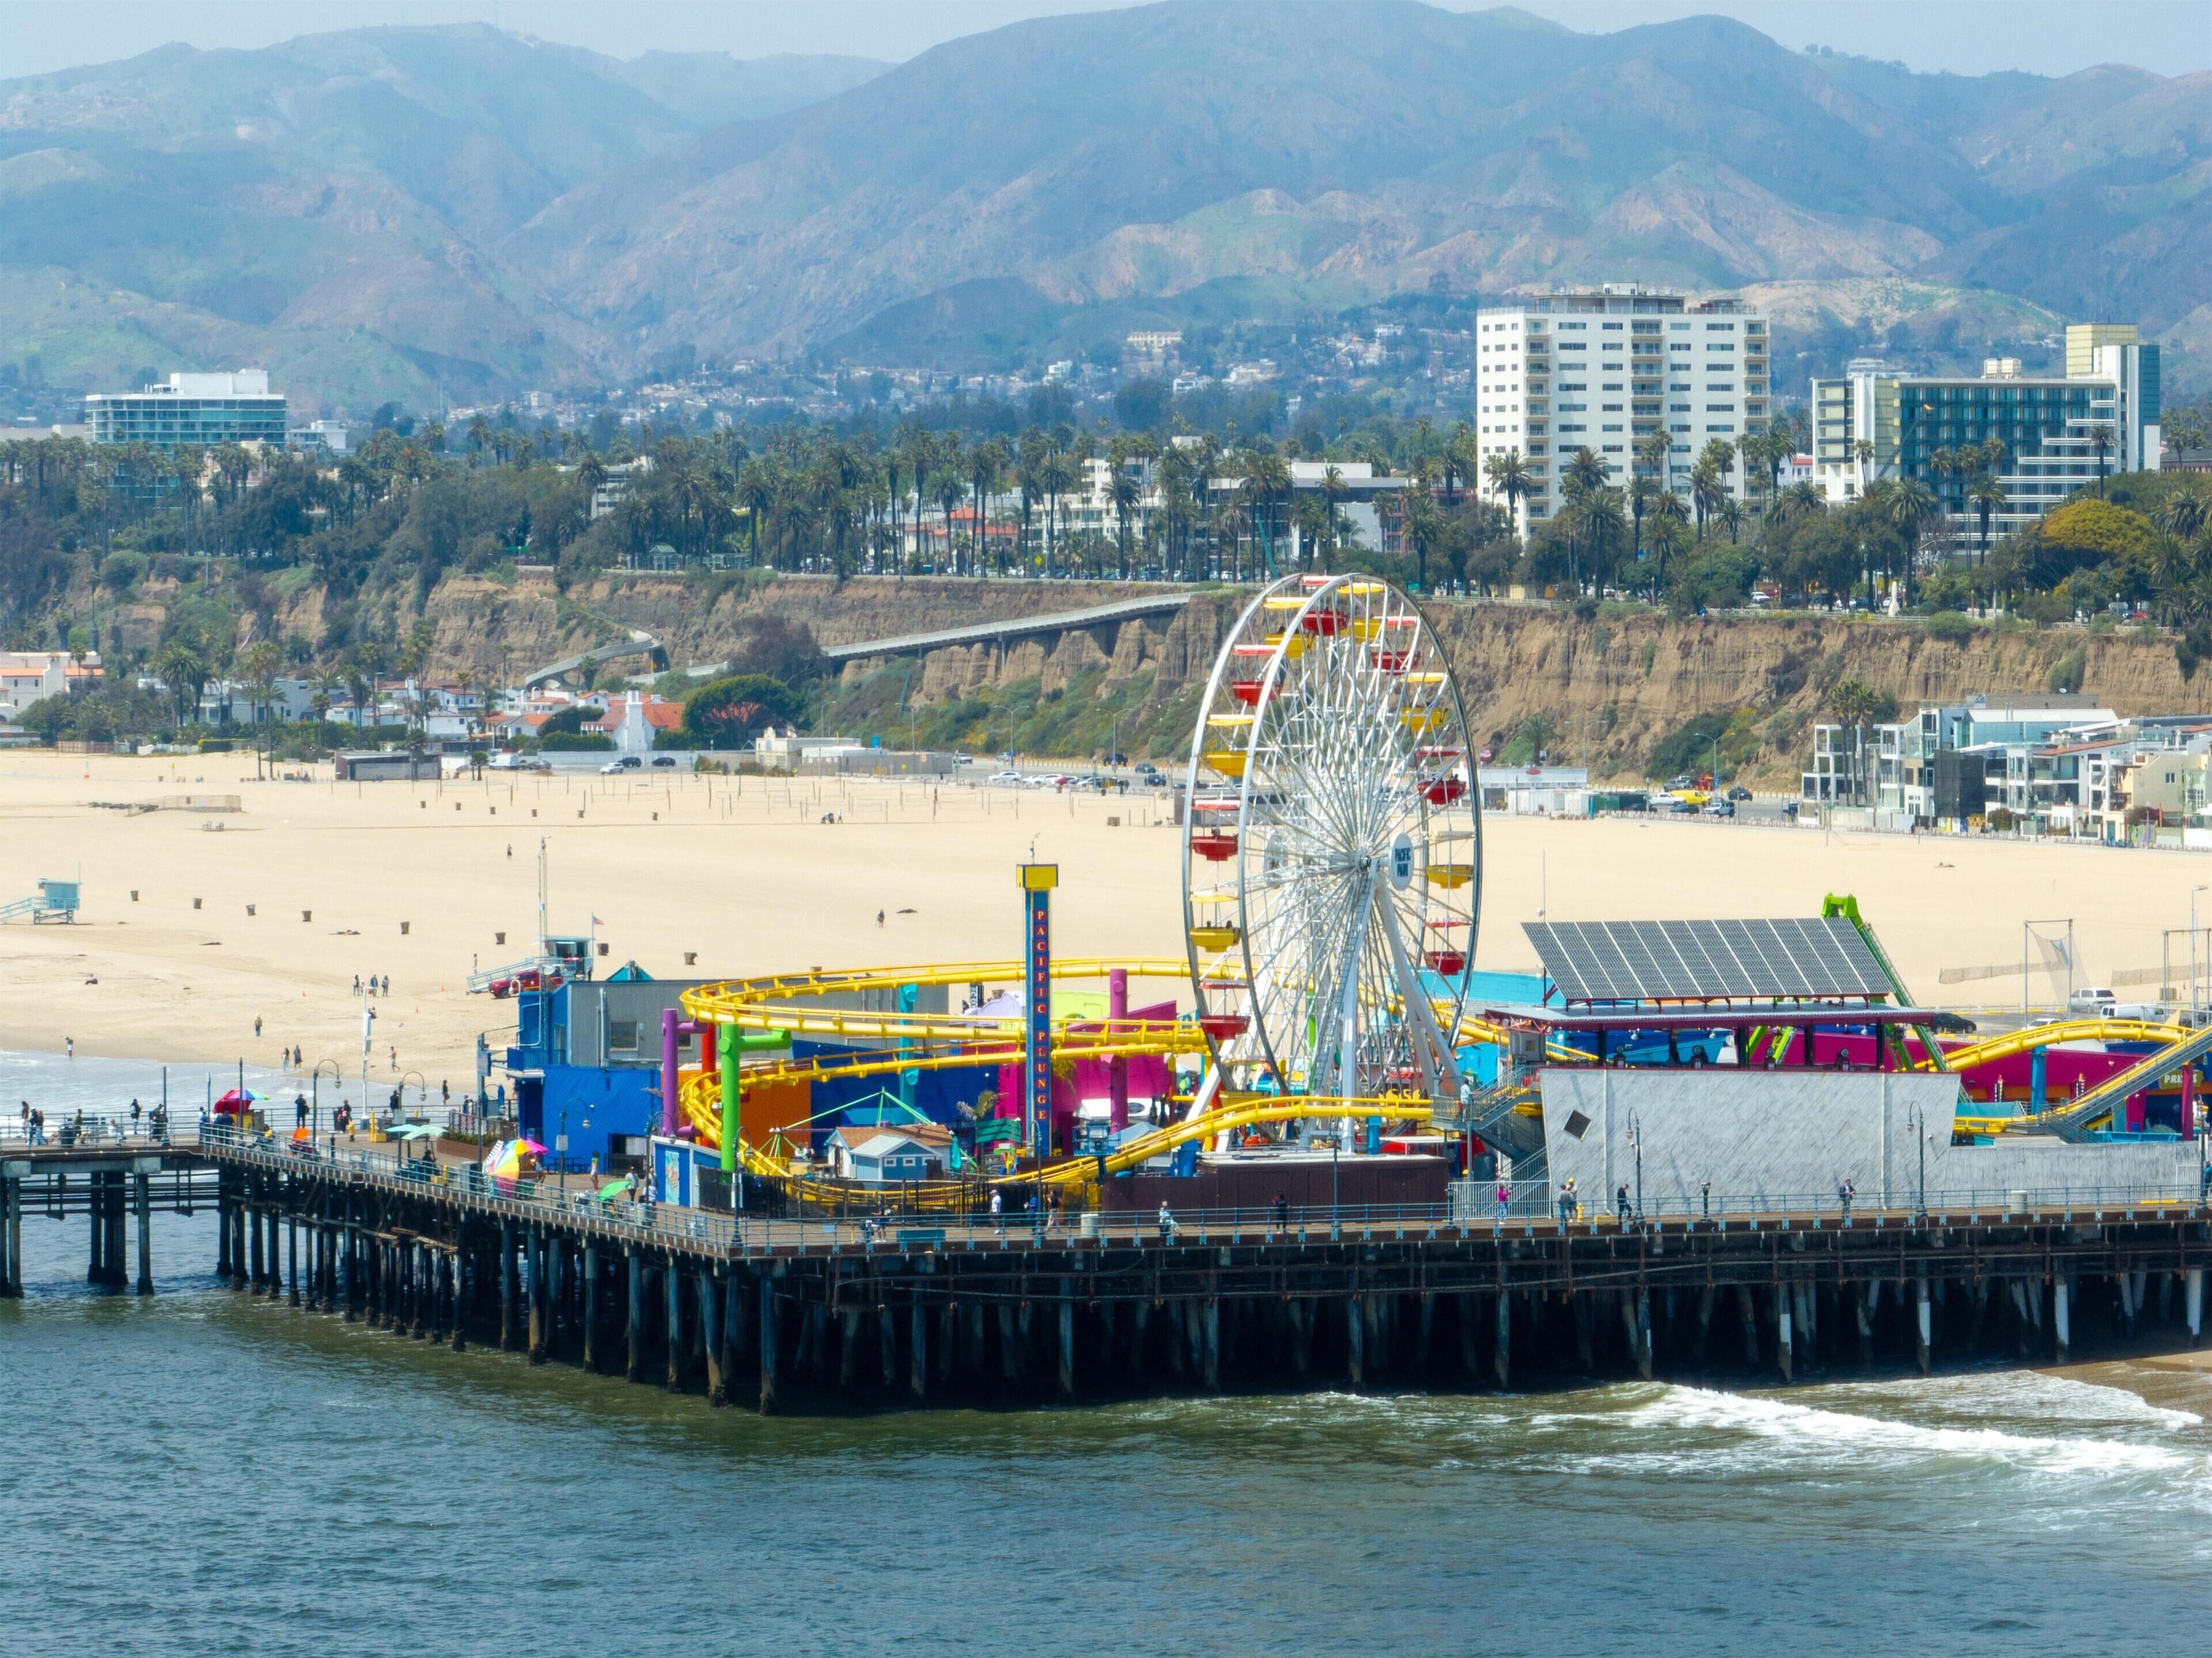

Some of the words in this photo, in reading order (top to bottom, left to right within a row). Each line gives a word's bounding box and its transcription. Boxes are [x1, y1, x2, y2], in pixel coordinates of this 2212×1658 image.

[1395, 847, 1411, 862] PACIFIC
[1397, 863, 1408, 877] PARK
[1037, 911, 1046, 1013] PACIFIC
[1037, 1032, 1046, 1119] PLUNGE
[2164, 1074, 2198, 1084] PRIS
